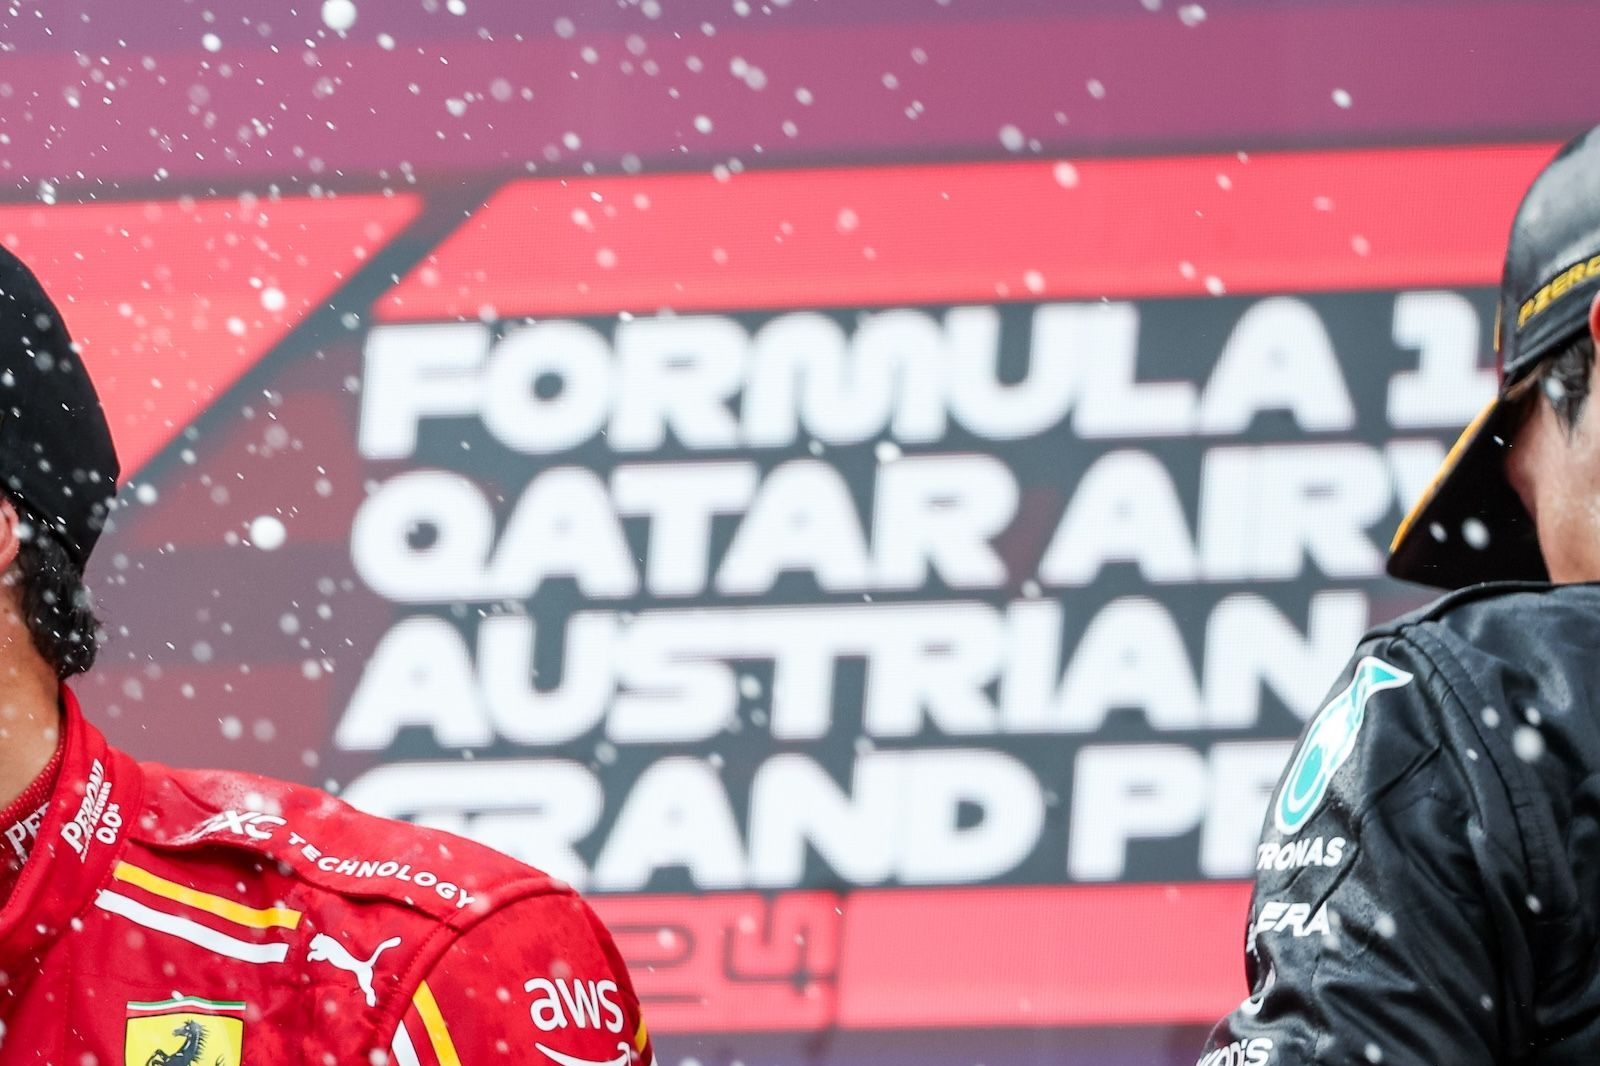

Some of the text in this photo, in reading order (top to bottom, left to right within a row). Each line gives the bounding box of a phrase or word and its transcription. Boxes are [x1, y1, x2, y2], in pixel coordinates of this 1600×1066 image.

[357, 290, 1500, 459] FORMULA 1
[350, 453, 1021, 601] QATAR
[336, 588, 1368, 750] AUSTRIAN
[287, 831, 477, 909] TECHNOLOGY
[524, 976, 625, 1034] aws
